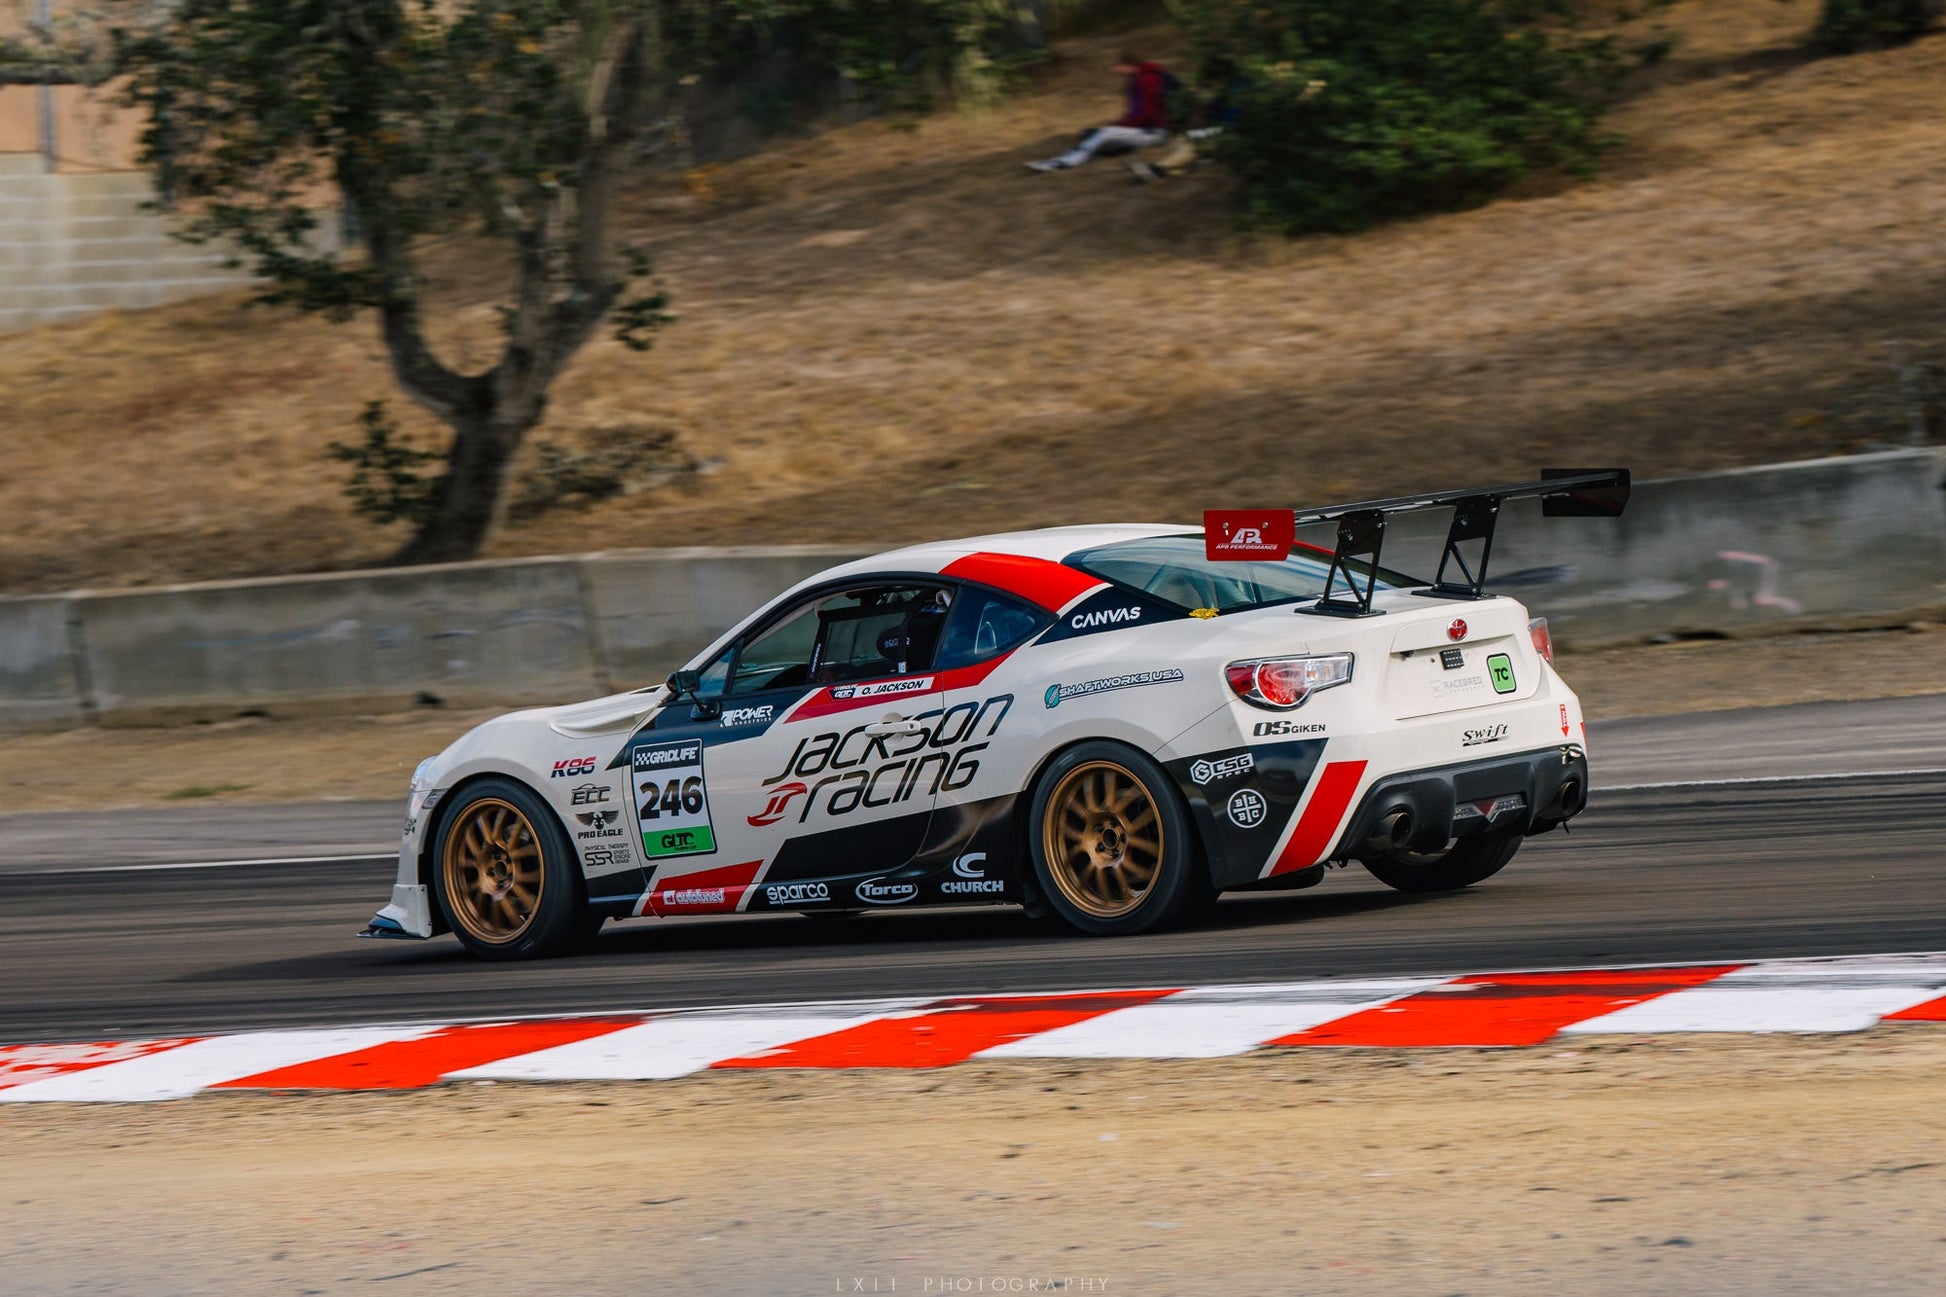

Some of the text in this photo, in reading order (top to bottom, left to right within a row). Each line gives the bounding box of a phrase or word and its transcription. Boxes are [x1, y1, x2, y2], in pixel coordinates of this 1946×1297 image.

[1071, 606, 1141, 629] CANVAS
[1059, 672, 1150, 697] SHAFTWORKS
[1152, 669, 1183, 681] USA
[1494, 667, 1509, 682] TC
[862, 687, 872, 695] O.
[873, 680, 924, 694] JACKSON
[732, 705, 774, 722] POWER
[1462, 723, 1508, 742] Swift
[649, 747, 699, 765] GRIDLIFE
[1213, 755, 1250, 774] CSG
[551, 756, 597, 778] K86
[639, 776, 704, 820] 246
[578, 828, 623, 839] PRO EAGLE
[585, 851, 614, 866] SSR
[766, 882, 913, 905] sparco Torco
[941, 880, 1004, 894] CHURCH
